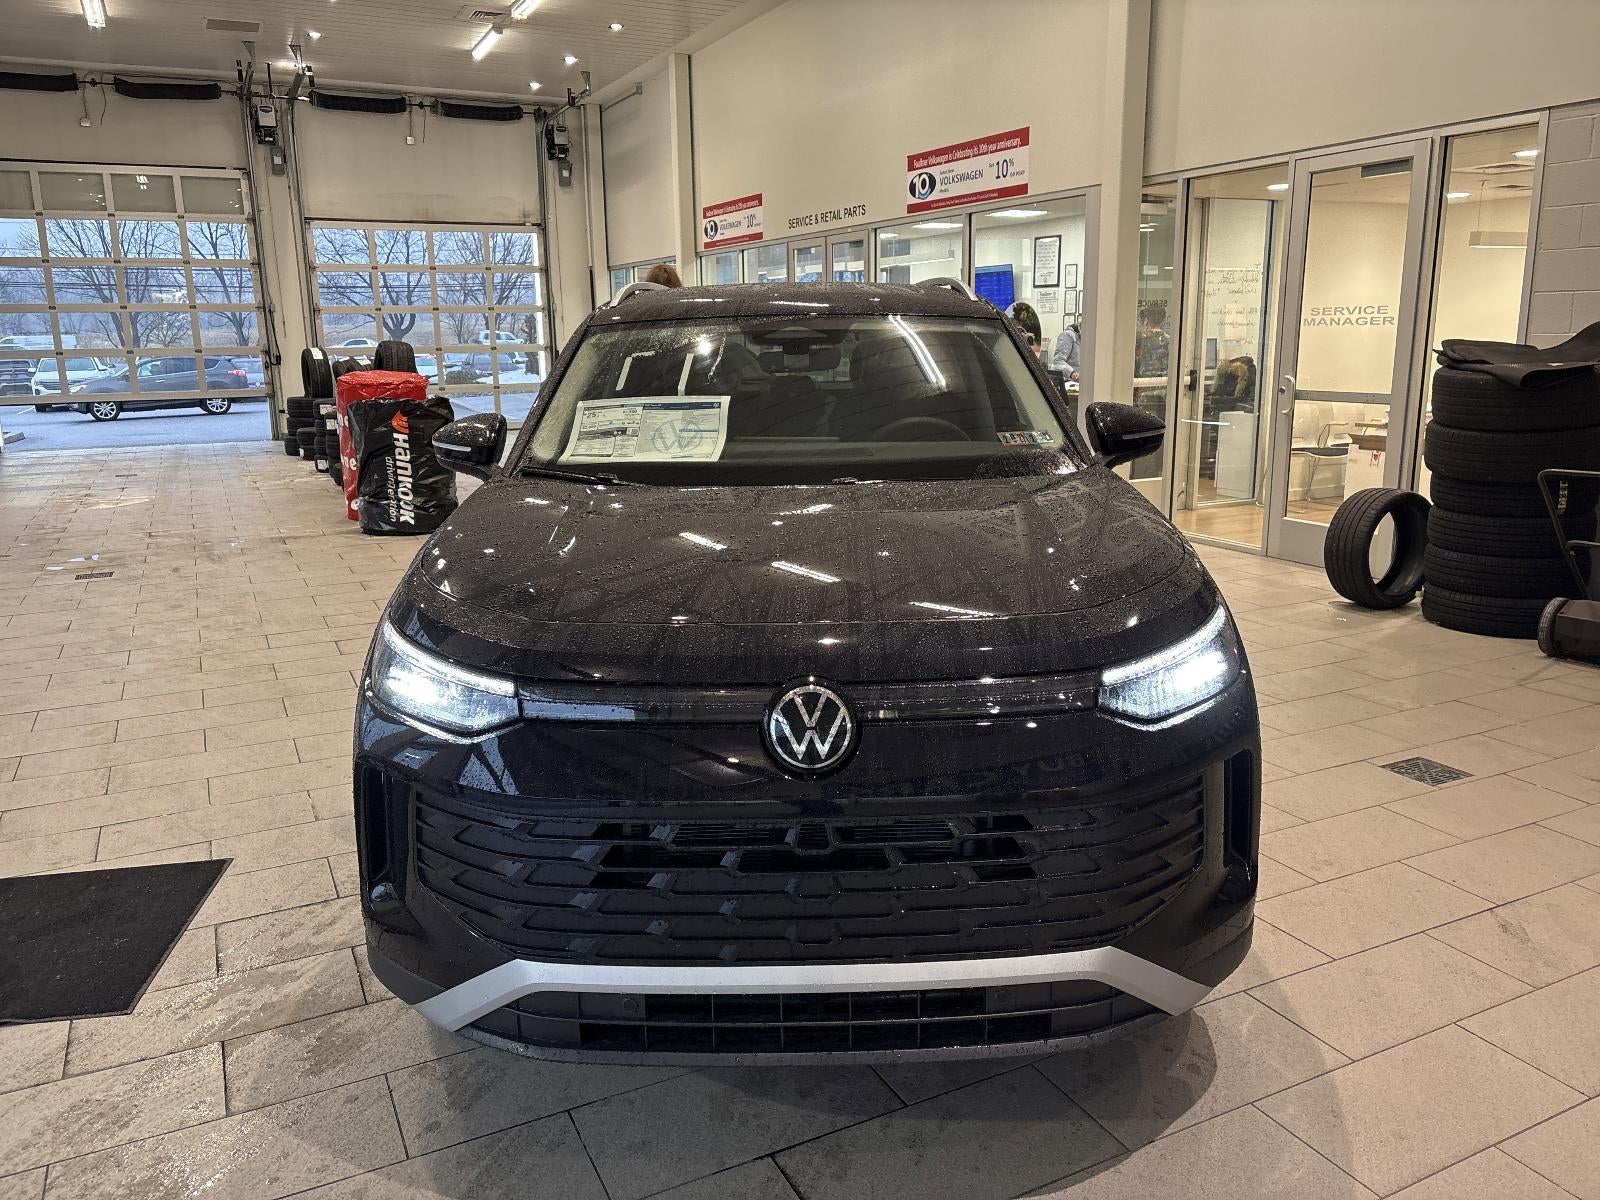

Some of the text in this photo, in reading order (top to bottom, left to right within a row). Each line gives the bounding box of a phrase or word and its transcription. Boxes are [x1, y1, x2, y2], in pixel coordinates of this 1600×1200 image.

[928, 154, 948, 165] Volkswagen
[940, 169, 984, 186] VOLKSWAGEN
[912, 173, 930, 198] 10
[788, 204, 866, 229] SERVICE & RETAIL PARTS
[1310, 305, 1389, 316] SERVICE
[1303, 316, 1396, 327] MANAGER
